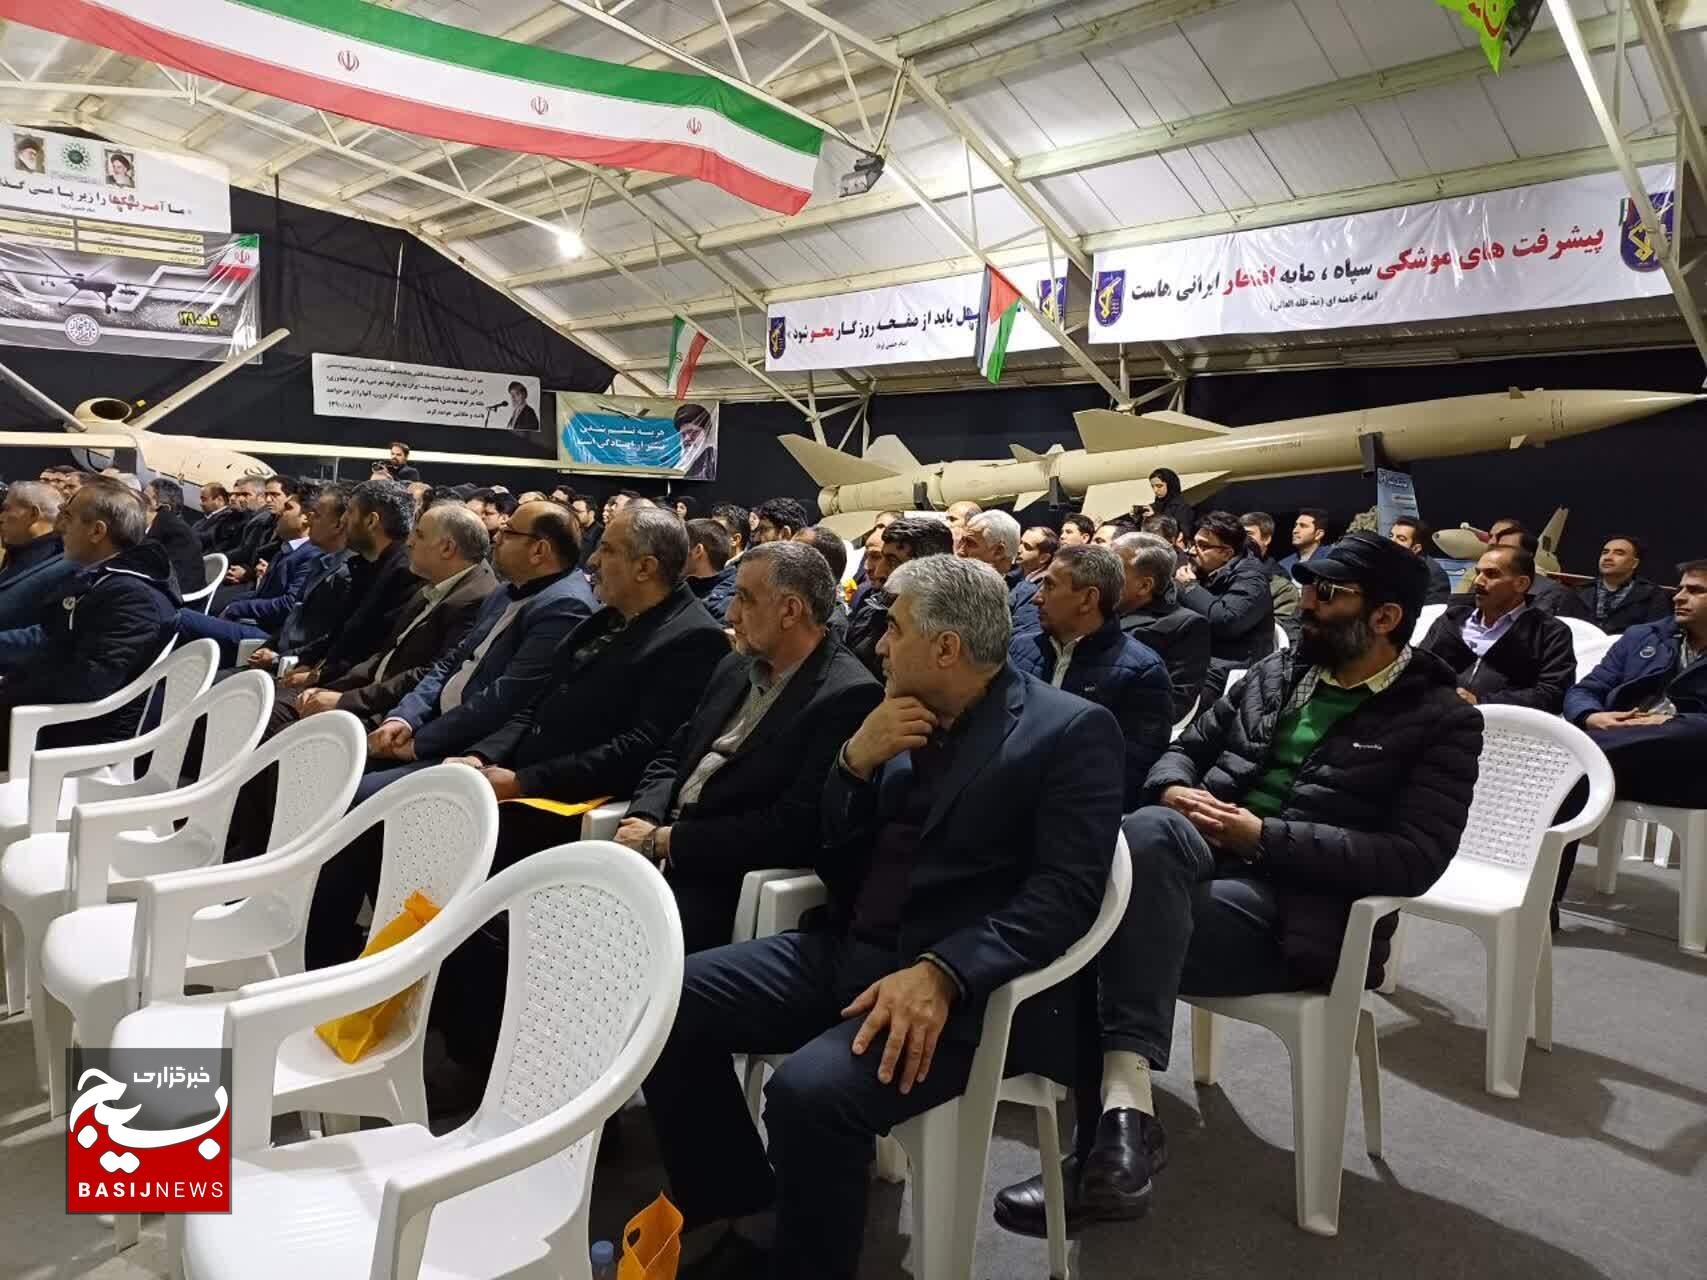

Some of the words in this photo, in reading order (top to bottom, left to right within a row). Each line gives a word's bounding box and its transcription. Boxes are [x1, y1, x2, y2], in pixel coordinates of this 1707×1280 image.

[1459, 241, 1505, 270] های
[1512, 225, 1605, 260] پیشرفت
[1279, 262, 1316, 289] مایه
[1333, 257, 1373, 285] سپاه
[1376, 247, 1451, 281] موشکی
[1131, 278, 1172, 300] هاست
[1176, 270, 1220, 301] ایرانی
[1222, 263, 1277, 296] افتخار
[876, 313, 919, 330] صفحه
[921, 310, 932, 331] از
[934, 307, 954, 328] باید
[810, 327, 834, 343] محو
